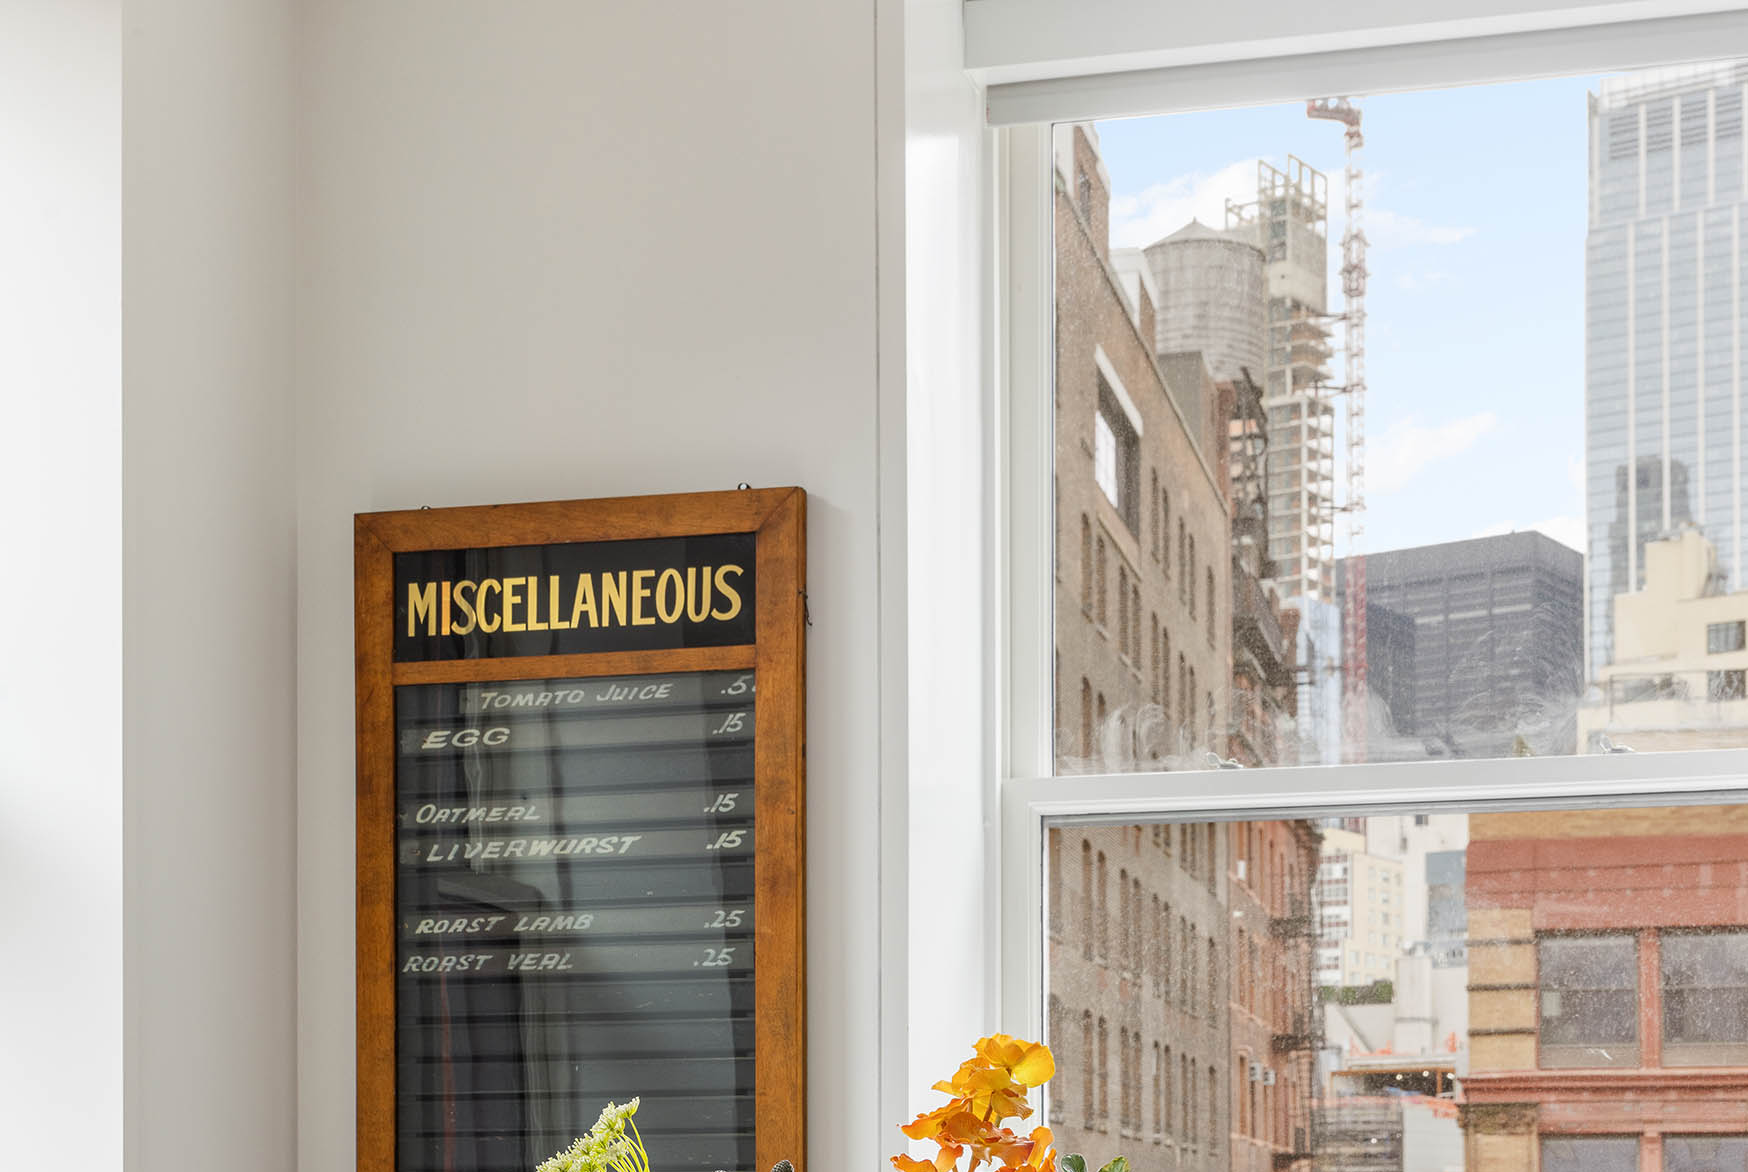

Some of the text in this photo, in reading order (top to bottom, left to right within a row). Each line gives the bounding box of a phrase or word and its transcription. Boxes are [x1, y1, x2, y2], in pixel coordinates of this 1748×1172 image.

[407, 565, 744, 637] MISCELLANEOUS
[481, 674, 756, 710] TOMATO JUICE .5
[421, 712, 746, 750] EGG .15
[415, 793, 739, 824] OATMEAL .15
[426, 830, 747, 862] LIVERWURST .15
[415, 910, 746, 935] ROAST LAMB .25
[402, 947, 736, 973] ROAST VEAL .25
